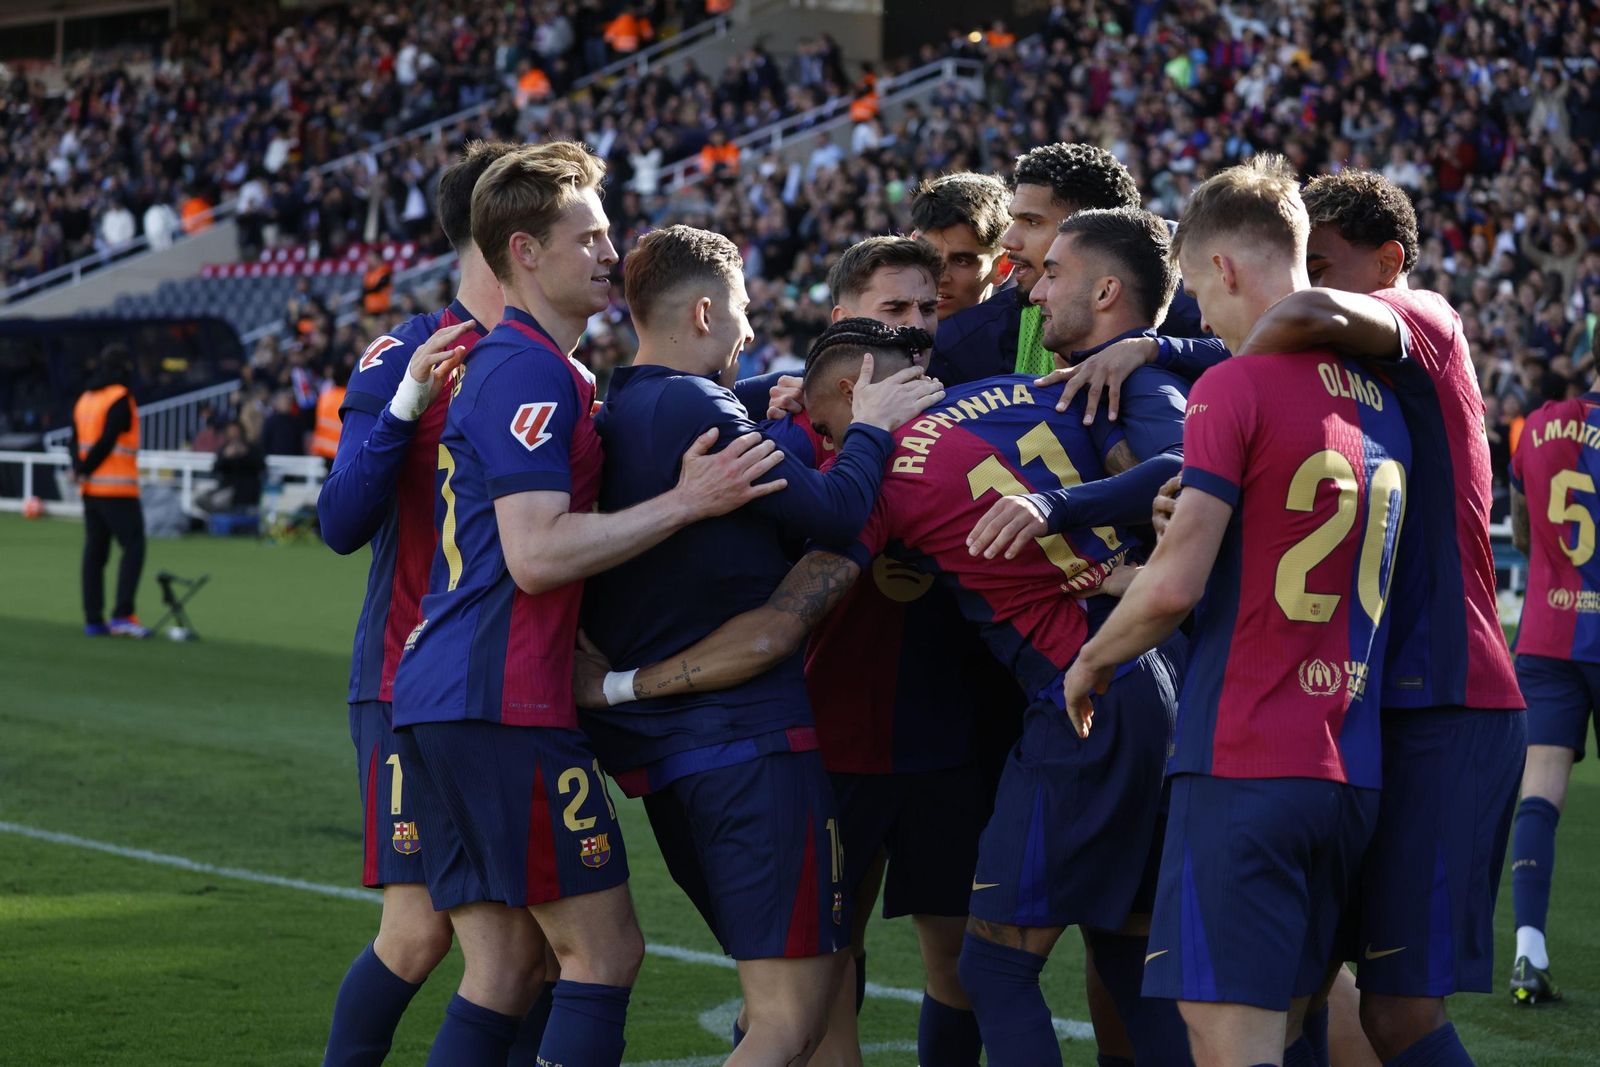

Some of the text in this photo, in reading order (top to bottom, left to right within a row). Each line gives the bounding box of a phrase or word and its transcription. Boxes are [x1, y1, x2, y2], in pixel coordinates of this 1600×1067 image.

[1317, 363, 1383, 412] OLMO
[1274, 449, 1407, 628] 20
[1547, 469, 1596, 567] 5
[557, 757, 616, 832] 21
